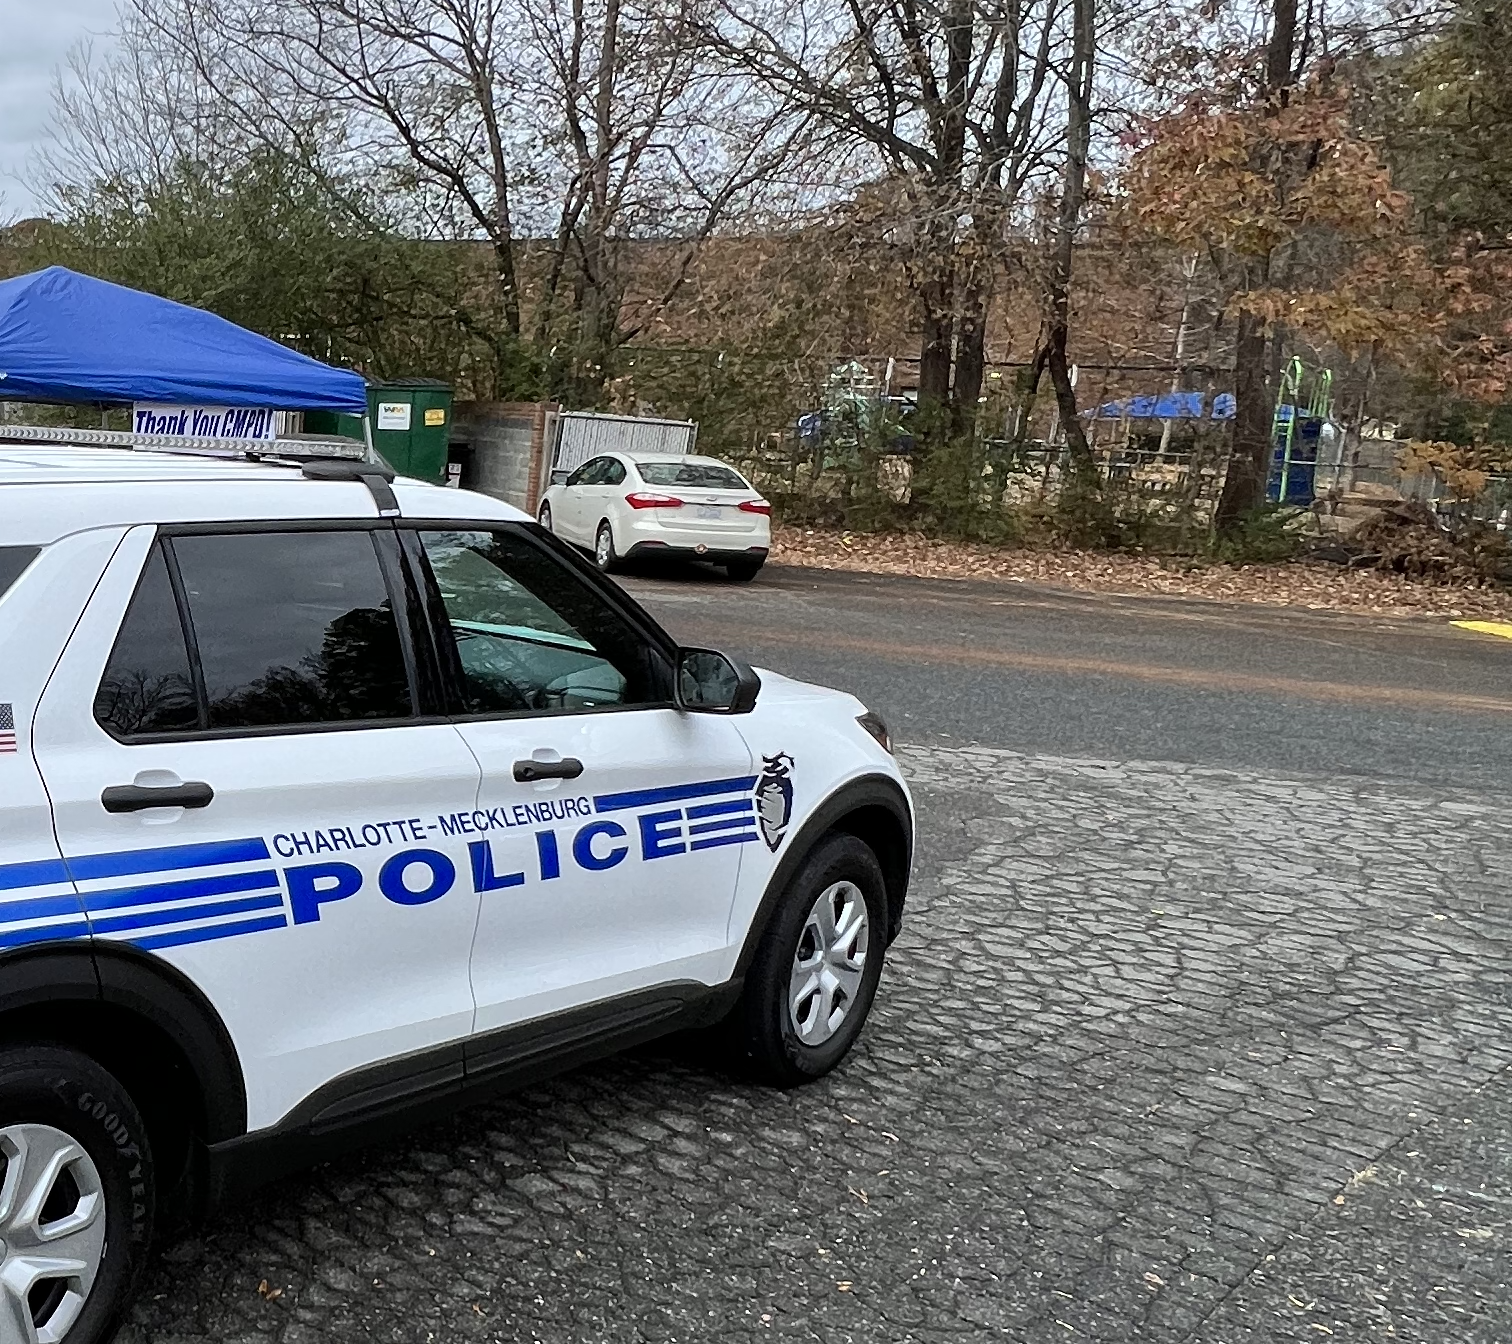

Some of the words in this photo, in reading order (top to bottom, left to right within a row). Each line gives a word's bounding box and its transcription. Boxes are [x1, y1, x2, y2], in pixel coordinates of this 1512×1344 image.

[135, 410, 188, 435] Thank
[191, 409, 221, 437] You
[220, 408, 274, 439] CMPD!
[272, 796, 592, 858] CHARLOTTE-MECKLENBURG
[282, 808, 688, 926] POLICE
